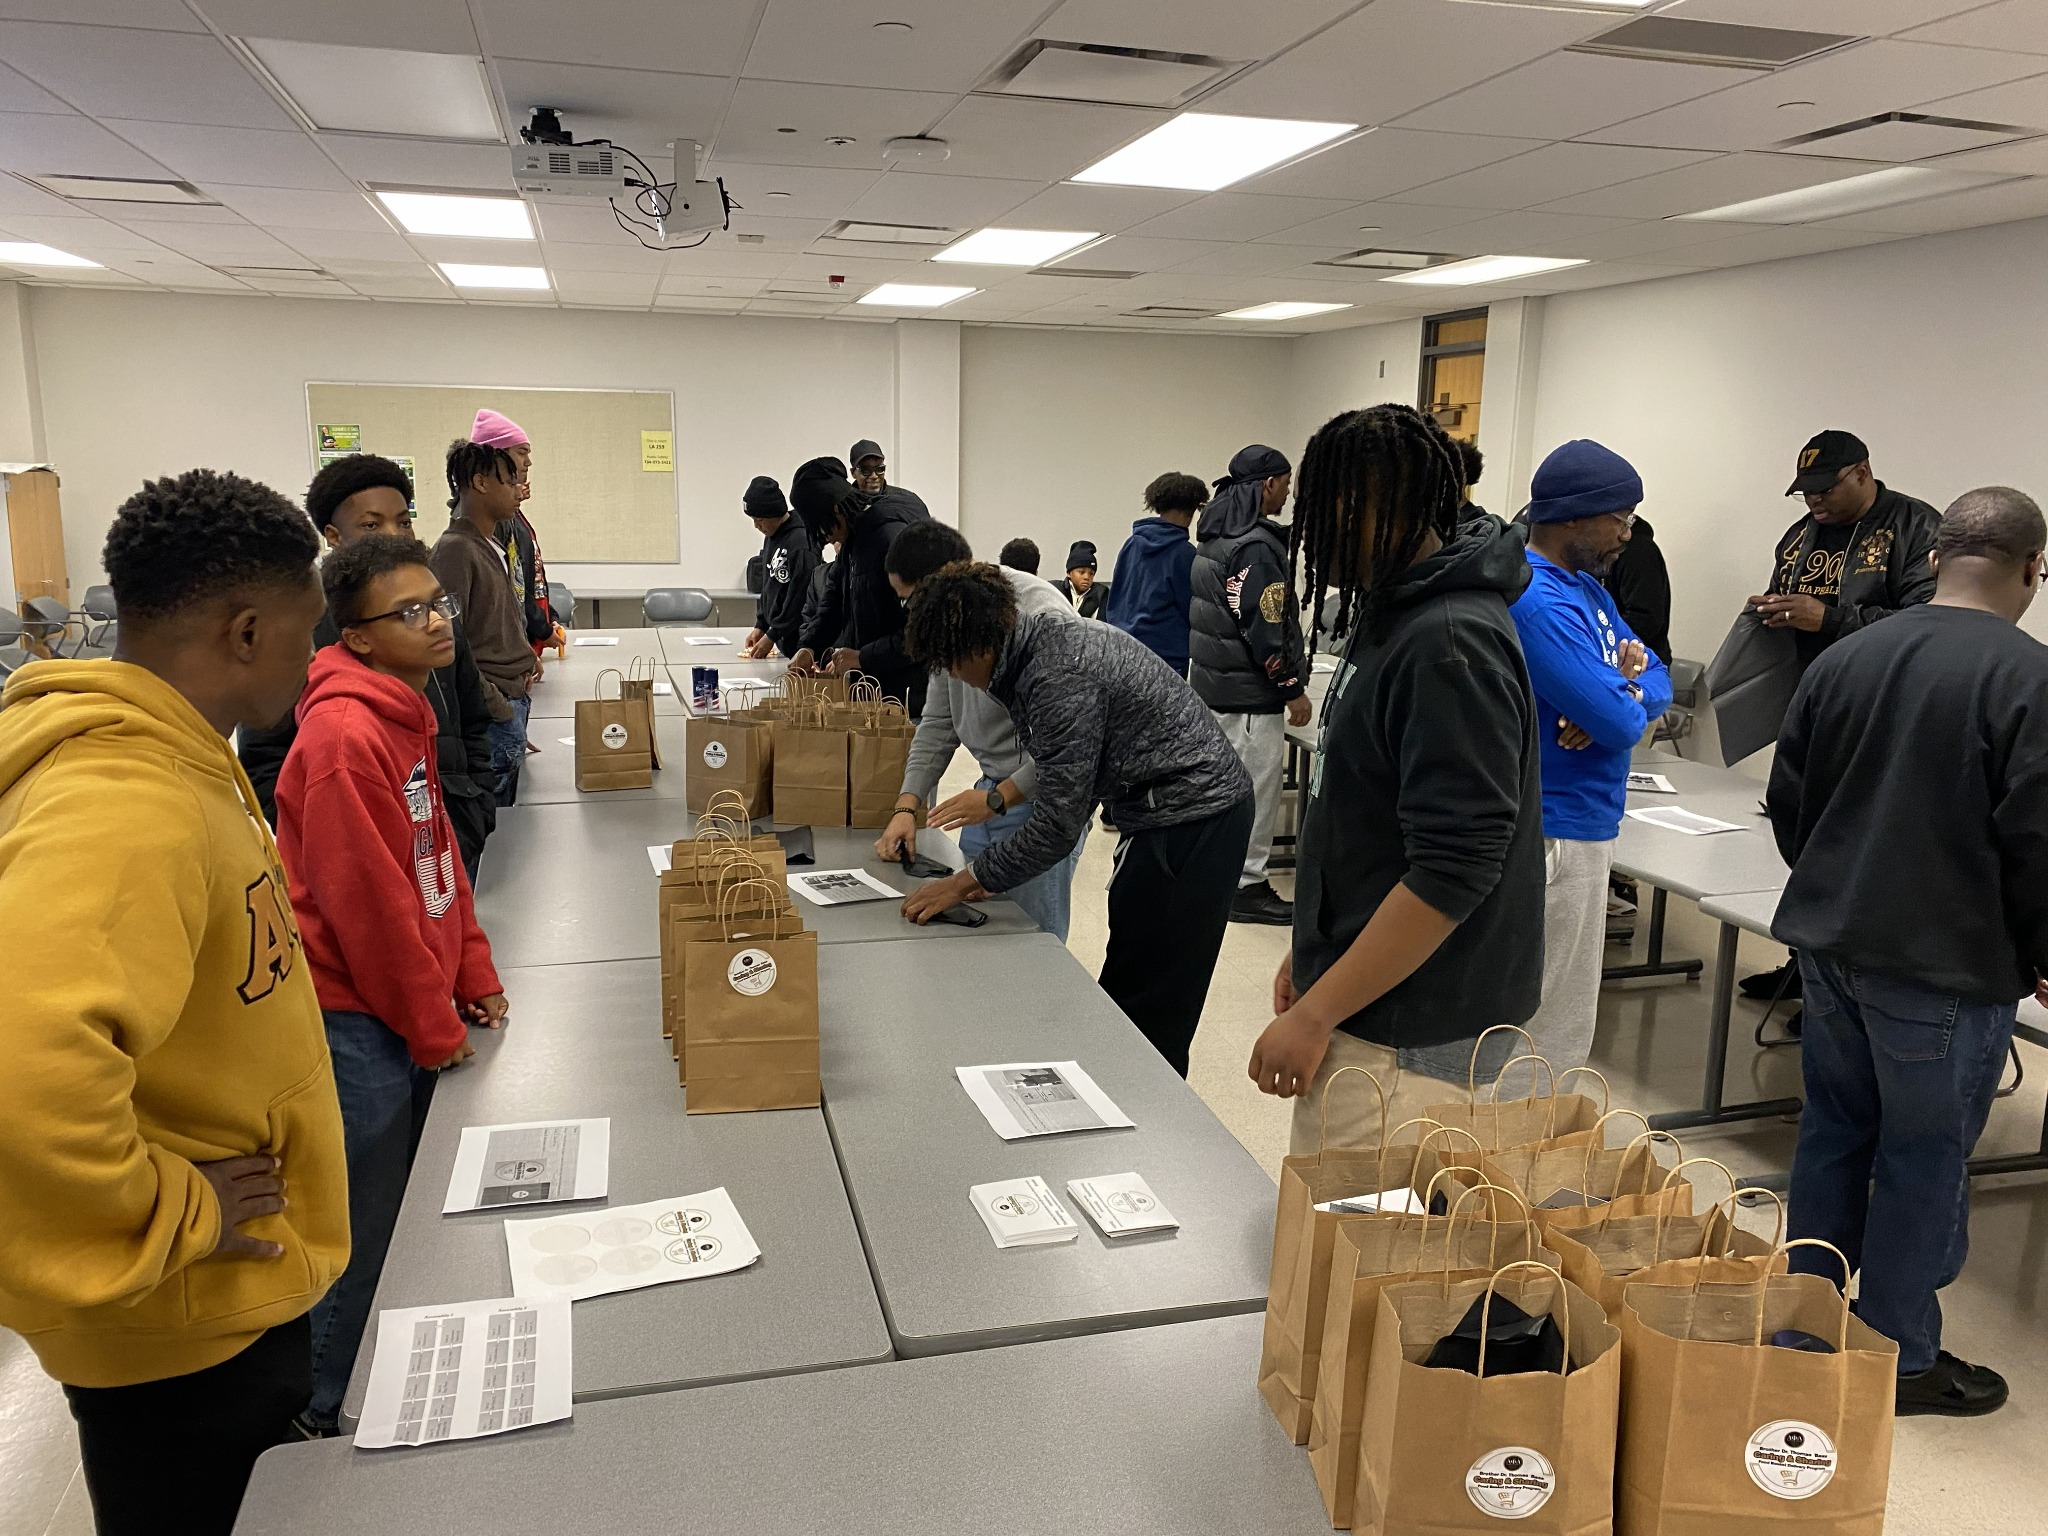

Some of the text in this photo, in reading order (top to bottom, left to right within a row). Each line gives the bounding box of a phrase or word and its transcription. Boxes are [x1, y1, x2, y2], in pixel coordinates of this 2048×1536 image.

[1799, 549, 1845, 584] 90
[1753, 1450, 1832, 1467] Caring & Sharing
[1473, 1475, 1503, 1485] Caring
[1512, 1477, 1549, 1489] Sharing
